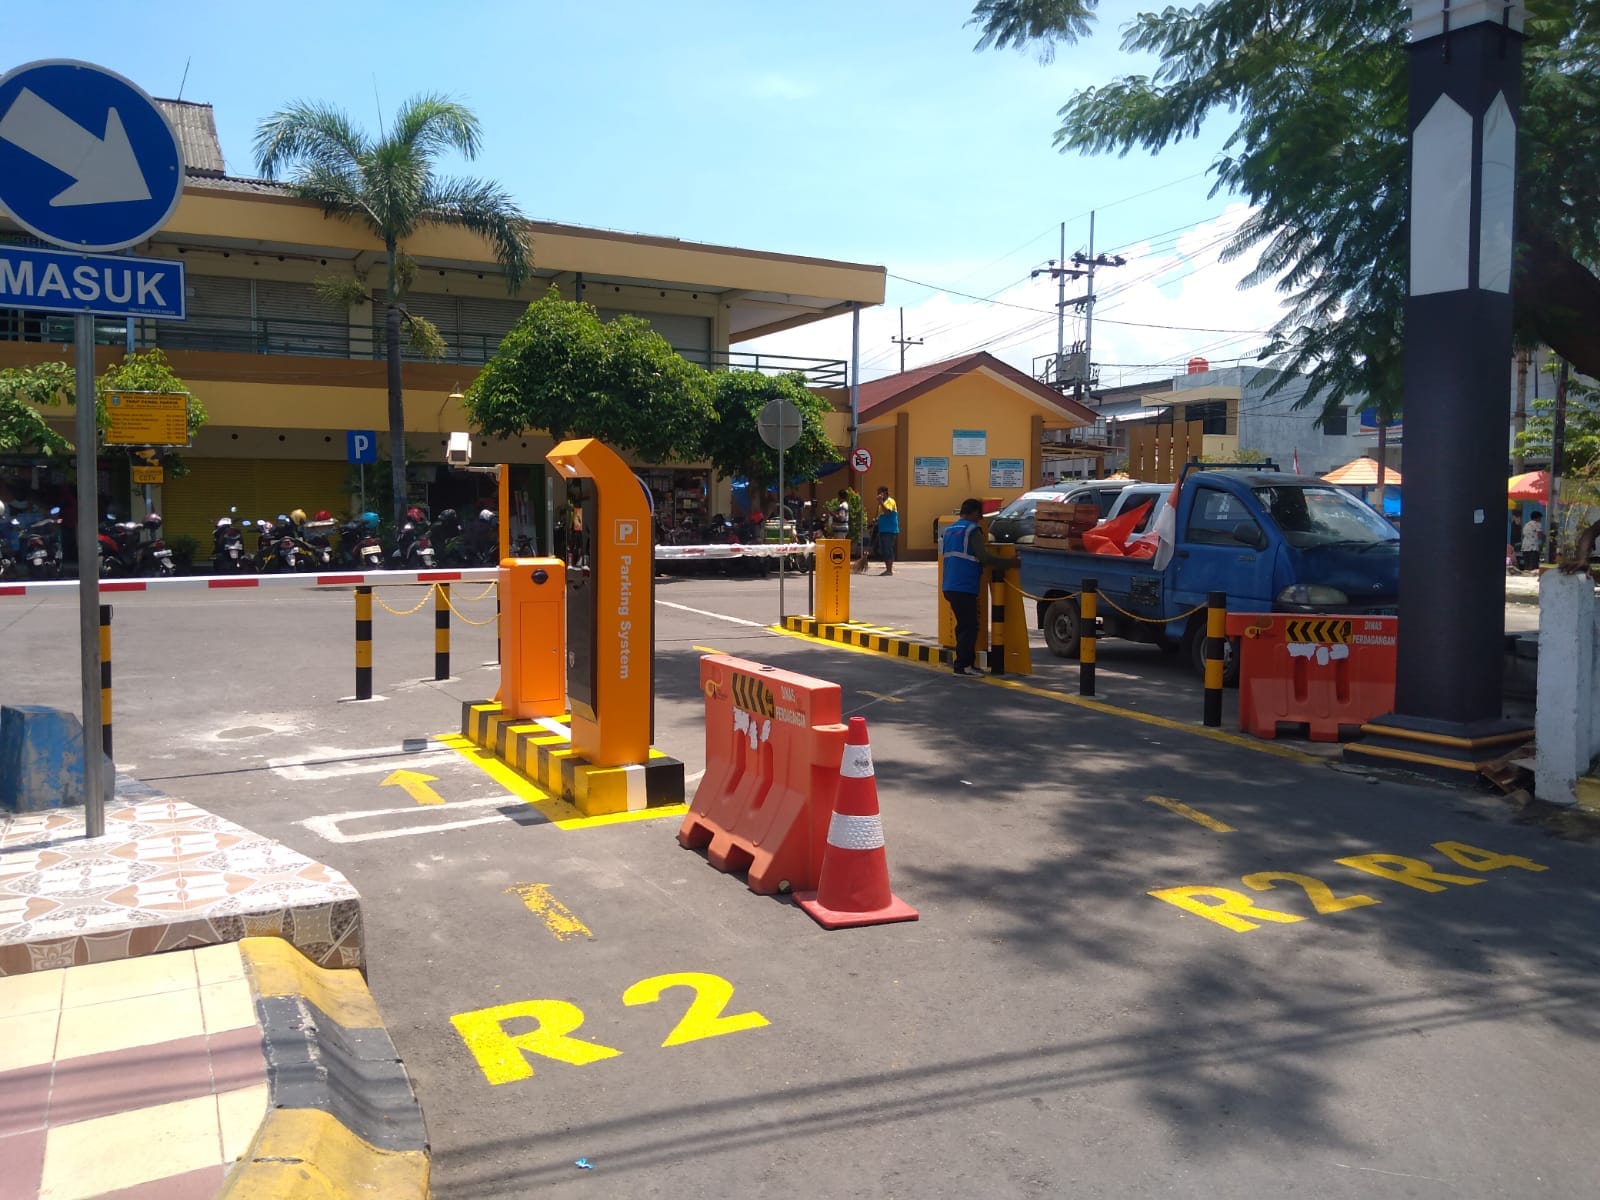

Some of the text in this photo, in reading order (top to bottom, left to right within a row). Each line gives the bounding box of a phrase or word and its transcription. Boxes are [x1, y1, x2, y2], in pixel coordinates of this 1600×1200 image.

[0, 258, 167, 306] MASUK
[354, 435, 369, 459] P
[619, 524, 633, 541] P
[618, 555, 632, 680] Parking System
[1364, 621, 1382, 631] DINAS
